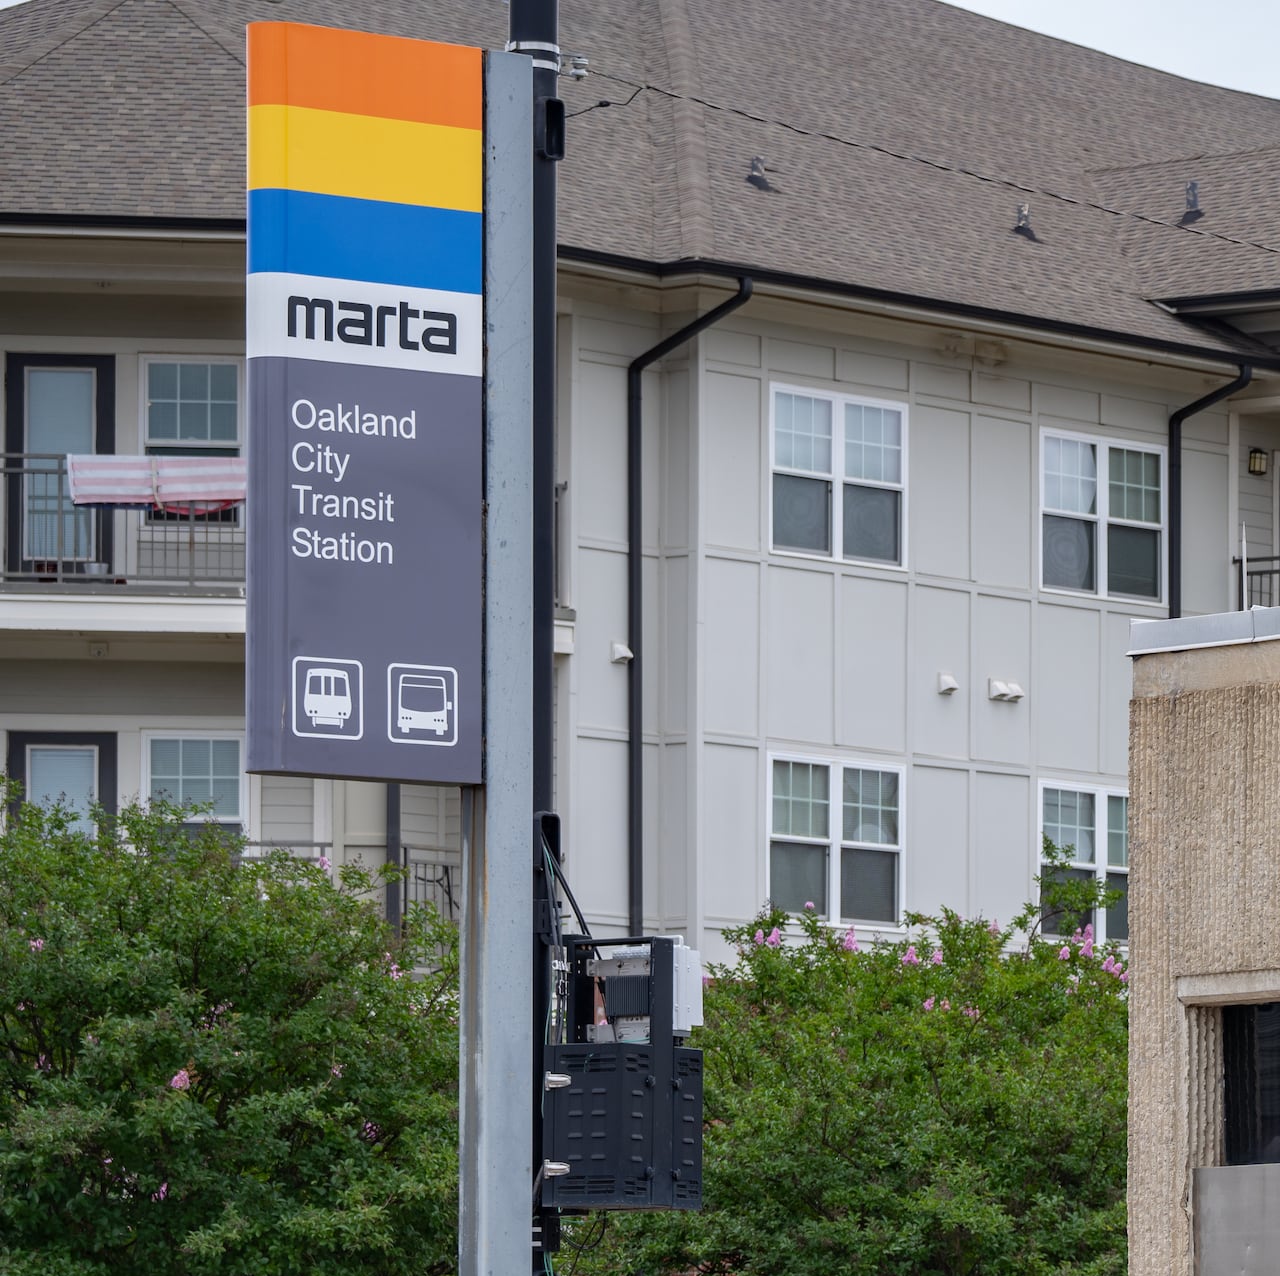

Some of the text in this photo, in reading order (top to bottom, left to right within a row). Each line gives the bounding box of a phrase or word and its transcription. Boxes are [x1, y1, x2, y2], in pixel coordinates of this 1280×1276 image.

[287, 295, 457, 355] marta
[291, 399, 417, 440] Oakland
[291, 442, 351, 483] City
[291, 484, 395, 522] Transit
[291, 527, 394, 565] Station
